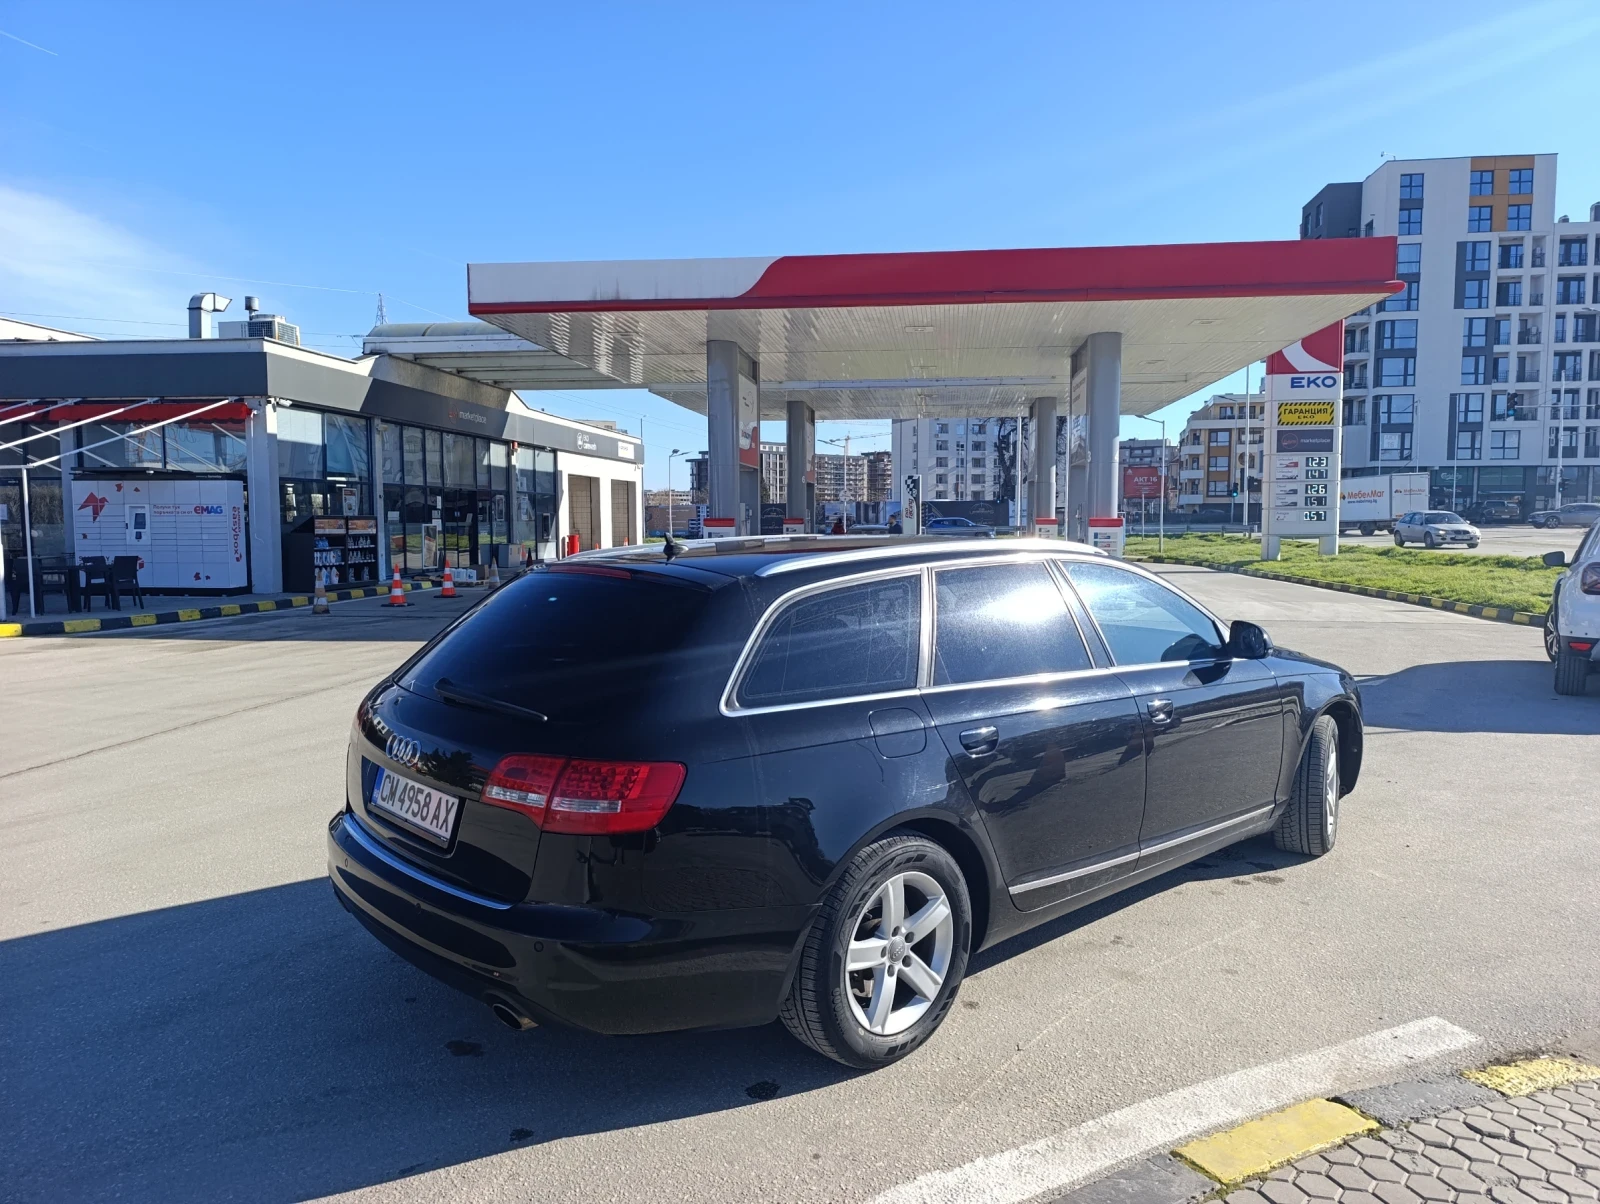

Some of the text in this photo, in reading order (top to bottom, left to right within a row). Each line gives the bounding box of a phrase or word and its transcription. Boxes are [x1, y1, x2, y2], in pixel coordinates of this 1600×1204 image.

[1290, 376, 1337, 389] EKO
[459, 411, 487, 424] marketplace
[1283, 407, 1328, 415] ГАРАНЦИЯ
[1347, 489, 1385, 500] МебелМаг
[193, 505, 224, 515] eMAG
[231, 506, 240, 555] easybox
[380, 774, 455, 833] CM 4958 AX
